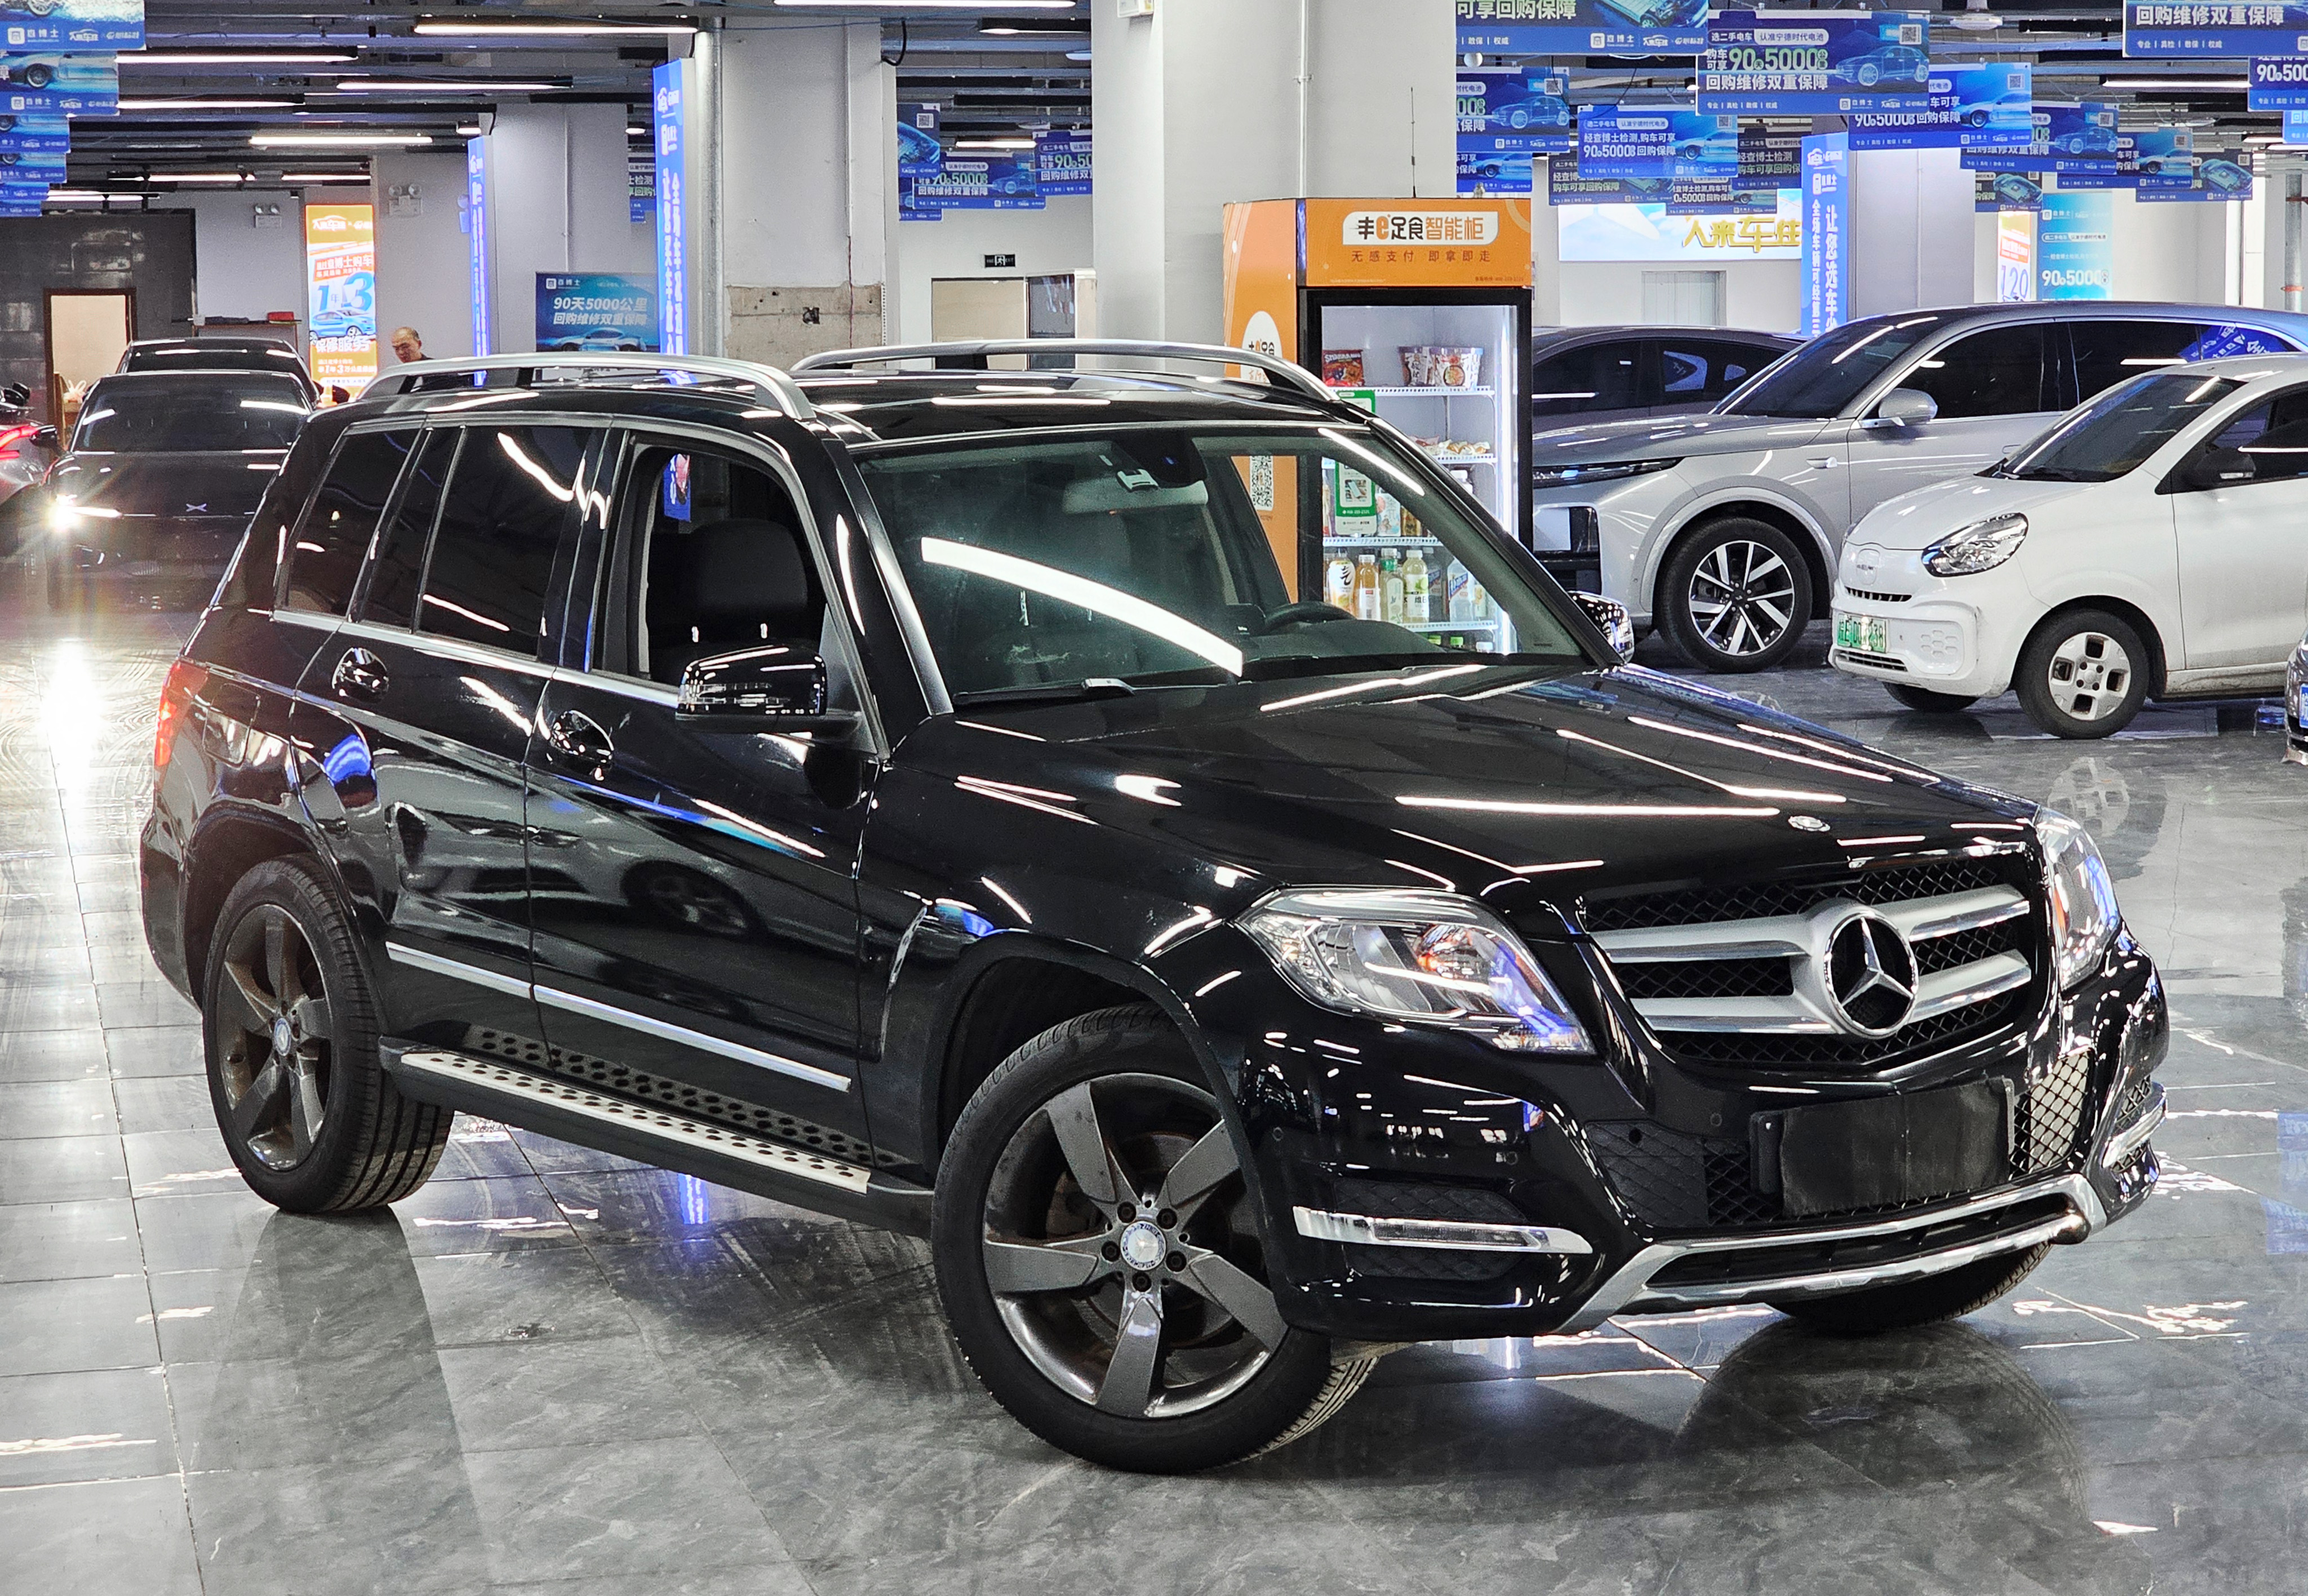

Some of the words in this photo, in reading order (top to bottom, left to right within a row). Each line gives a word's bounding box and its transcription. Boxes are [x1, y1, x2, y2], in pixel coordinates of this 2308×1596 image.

[1457, 0, 1577, 19] 可享回购保障
[2136, 6, 2284, 25] 回购维修双重保障
[1711, 32, 1752, 42] 选二手电车
[1760, 32, 1824, 41] 认准宁德时代电池
[1706, 74, 1828, 90] 回购维修双重保障
[1930, 96, 1960, 108] 车可享
[1738, 150, 1792, 162] 经查博士检测
[1738, 163, 1801, 175] 购车可享回购保
[918, 186, 988, 196] 回购维修双重保障
[1358, 215, 1484, 240] 丰e足食智能柜
[1351, 250, 1414, 263] 无感支付
[1429, 250, 1491, 263] 即拿即走
[553, 297, 647, 312] 90天5000公里
[553, 312, 647, 326] 回购维修双重保障
